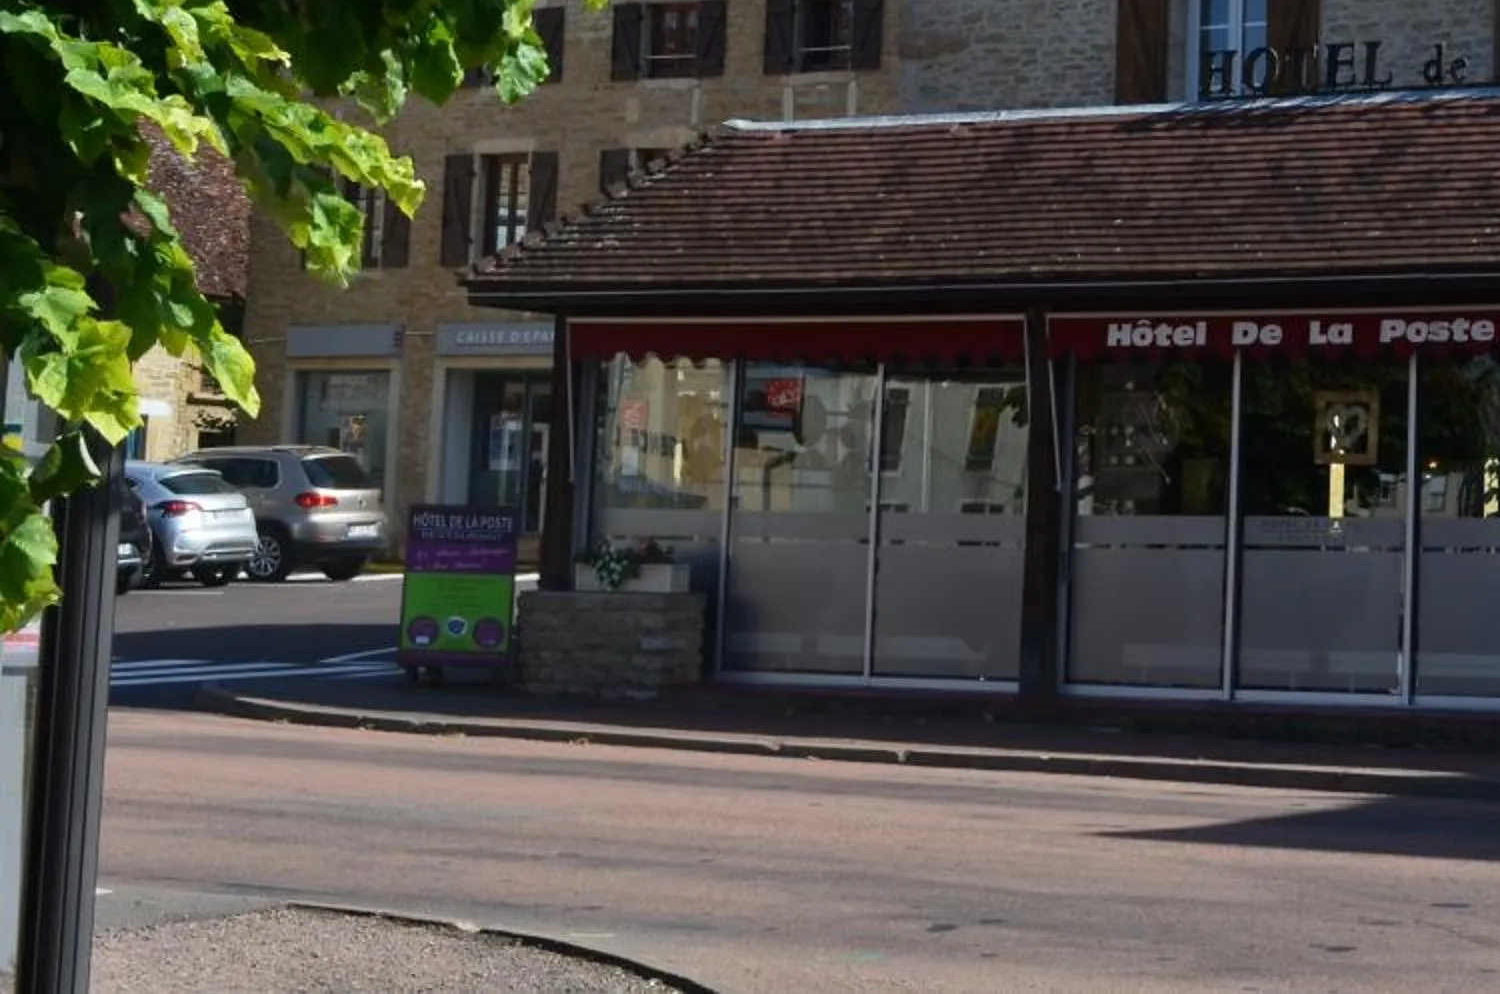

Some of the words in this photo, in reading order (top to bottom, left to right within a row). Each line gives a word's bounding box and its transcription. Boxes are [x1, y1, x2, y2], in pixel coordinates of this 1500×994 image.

[1424, 43, 1470, 84] de
[457, 330, 504, 344] CAISSE
[1106, 319, 1207, 347] Hôtel
[1232, 321, 1283, 346] De
[1309, 320, 1353, 344] La
[1380, 318, 1495, 344] Poste
